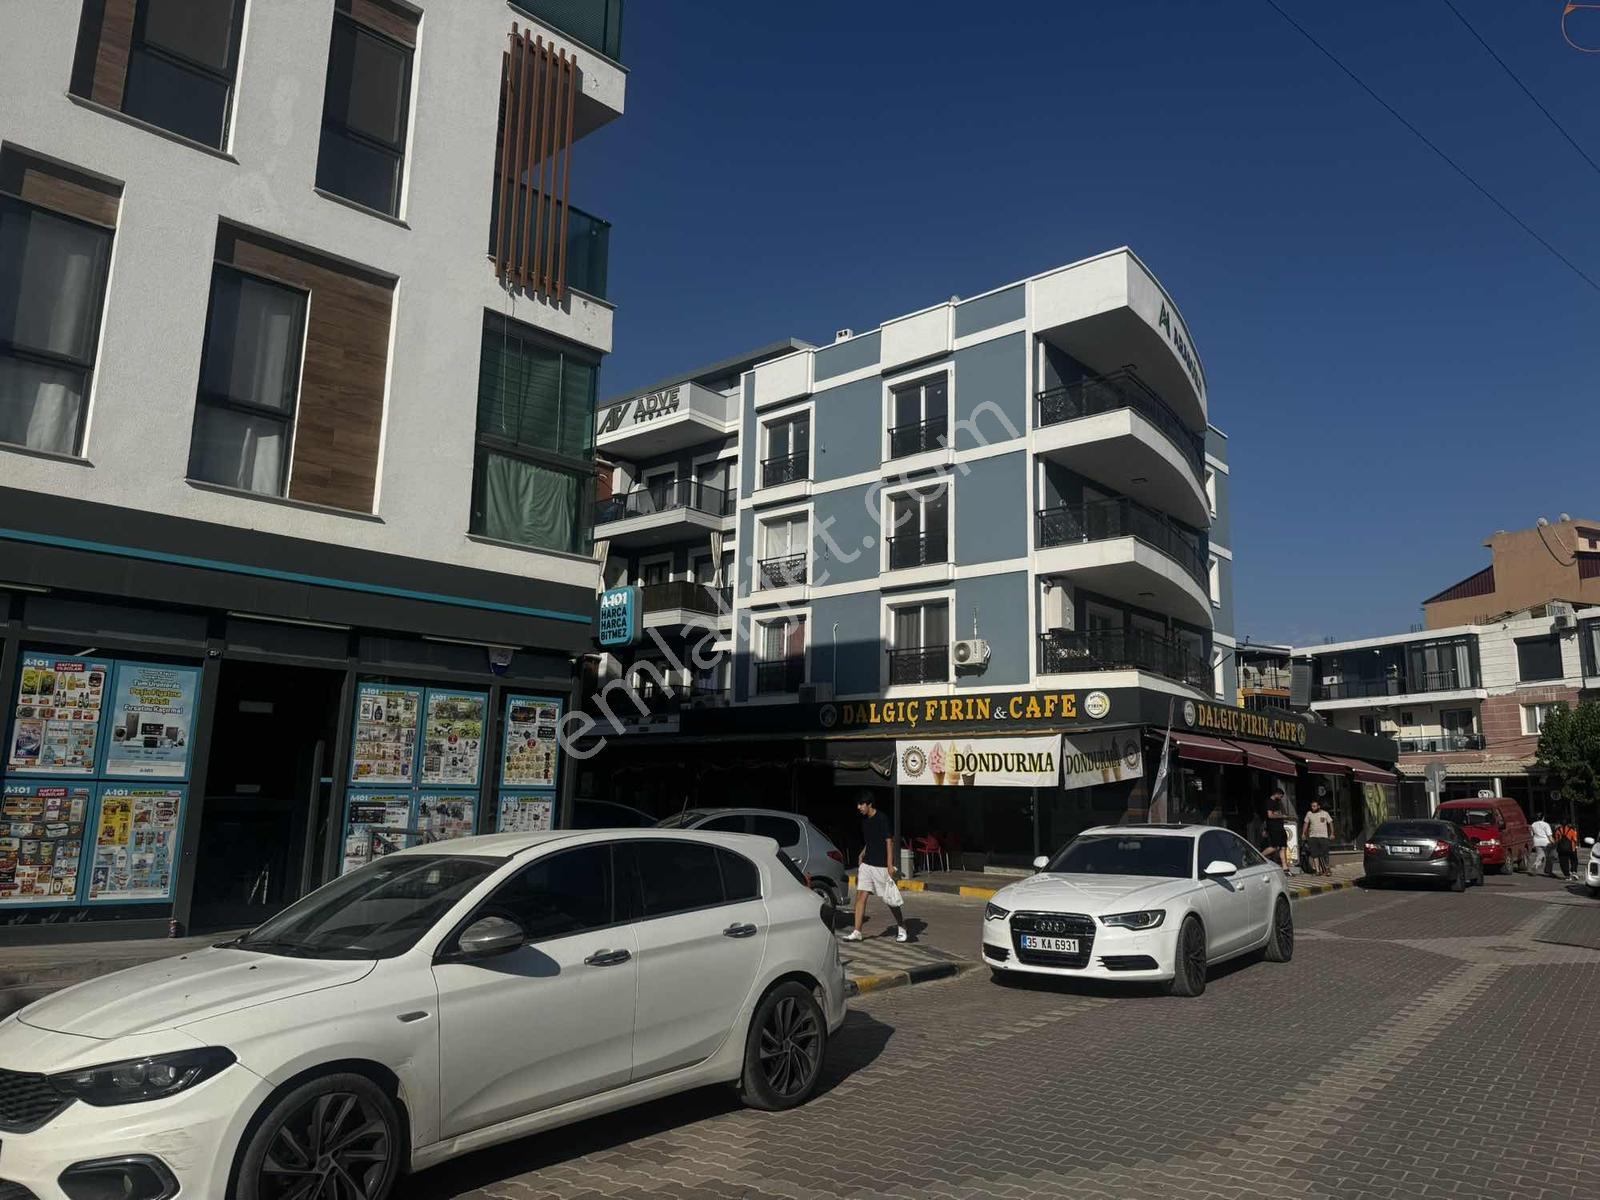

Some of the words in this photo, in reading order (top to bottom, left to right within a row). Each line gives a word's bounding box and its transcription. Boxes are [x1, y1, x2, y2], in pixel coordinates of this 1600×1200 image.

[634, 387, 680, 415] ADVE
[601, 592, 628, 608] A-101
[601, 607, 627, 619] HARCA
[601, 617, 627, 630] HARCA
[23, 659, 49, 667] A-101
[843, 700, 919, 728] DALGIÇ
[925, 698, 991, 721] FIRIN
[993, 706, 1008, 719] &
[1009, 693, 1077, 719] CAFE
[1198, 704, 1239, 738] DALGIÇ
[1241, 713, 1269, 737] FIRIN
[1274, 719, 1297, 742] CAFE
[954, 753, 1055, 773] DONDURMA
[1066, 750, 1121, 775] DONDURMA
[4, 786, 31, 794] A-101
[1027, 937, 1038, 948] 35
[1041, 938, 1053, 950] KA
[1055, 939, 1077, 951] 6931
